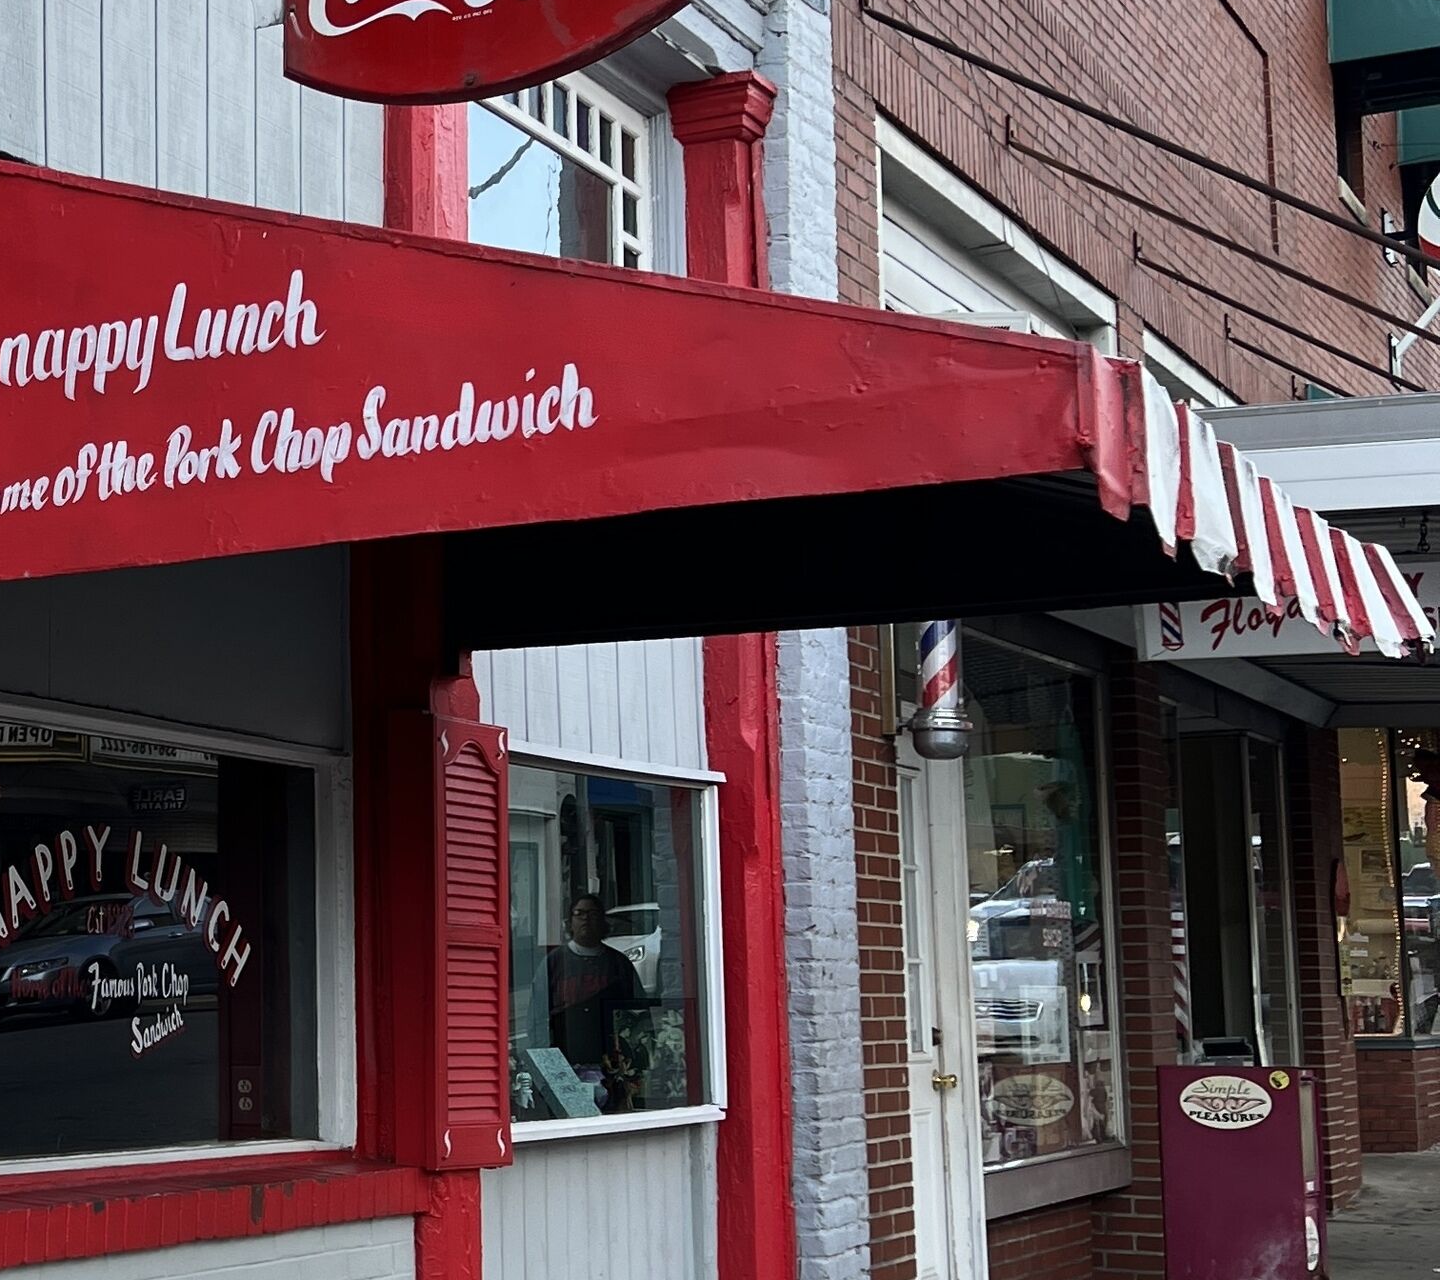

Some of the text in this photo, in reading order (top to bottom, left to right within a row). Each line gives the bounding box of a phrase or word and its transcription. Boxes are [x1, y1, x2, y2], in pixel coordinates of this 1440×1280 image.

[163, 269, 327, 362] Lunch
[52, 442, 98, 508] of
[96, 440, 156, 503] the
[163, 419, 243, 487] Pork
[251, 407, 352, 483] Chop
[357, 362, 598, 460] Sandwich
[131, 831, 251, 987] LUNCH
[87, 961, 135, 1011] Famous
[136, 961, 159, 1005] Pork
[162, 962, 190, 1007] Chop
[130, 1003, 184, 1054] Sandwich
[1191, 1079, 1251, 1098] Simple
